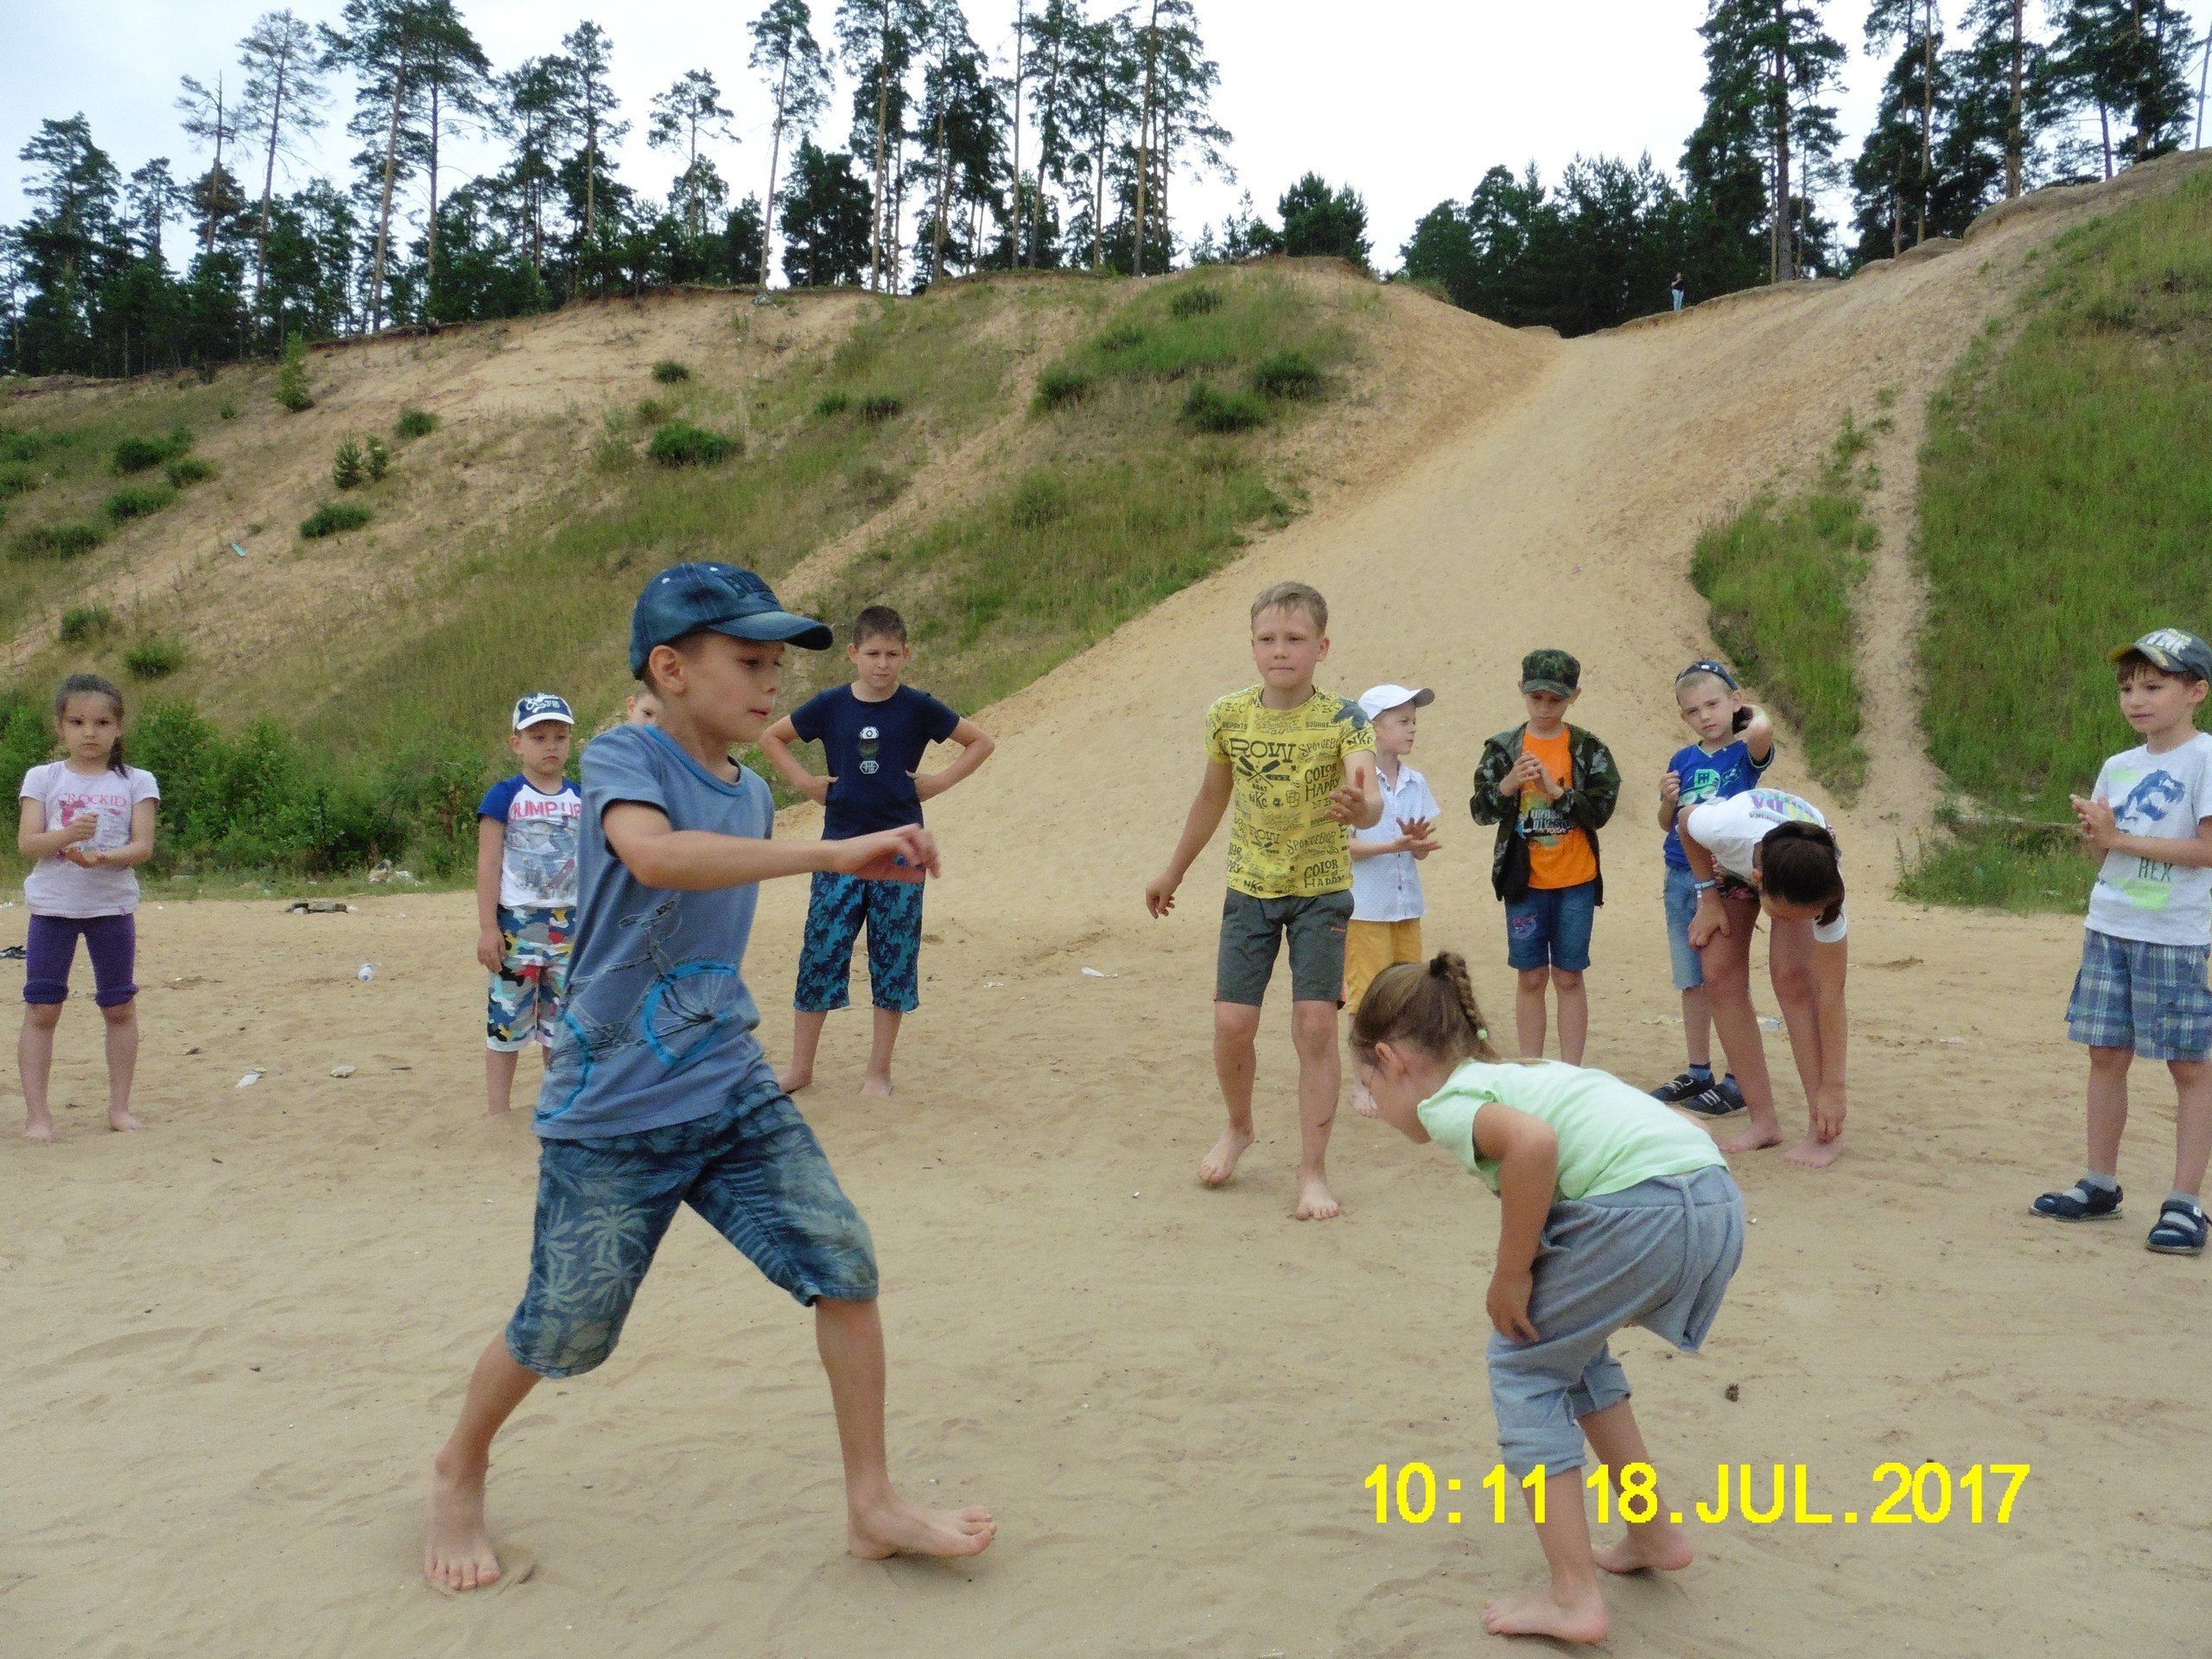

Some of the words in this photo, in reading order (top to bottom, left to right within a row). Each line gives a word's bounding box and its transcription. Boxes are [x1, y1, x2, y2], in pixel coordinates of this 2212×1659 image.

[1230, 738, 1296, 763] ROW
[1305, 762, 1337, 785] COLOR
[1305, 777, 1341, 802] HAPPY
[509, 800, 557, 823] JUMP
[1304, 859, 1338, 879] COLOR
